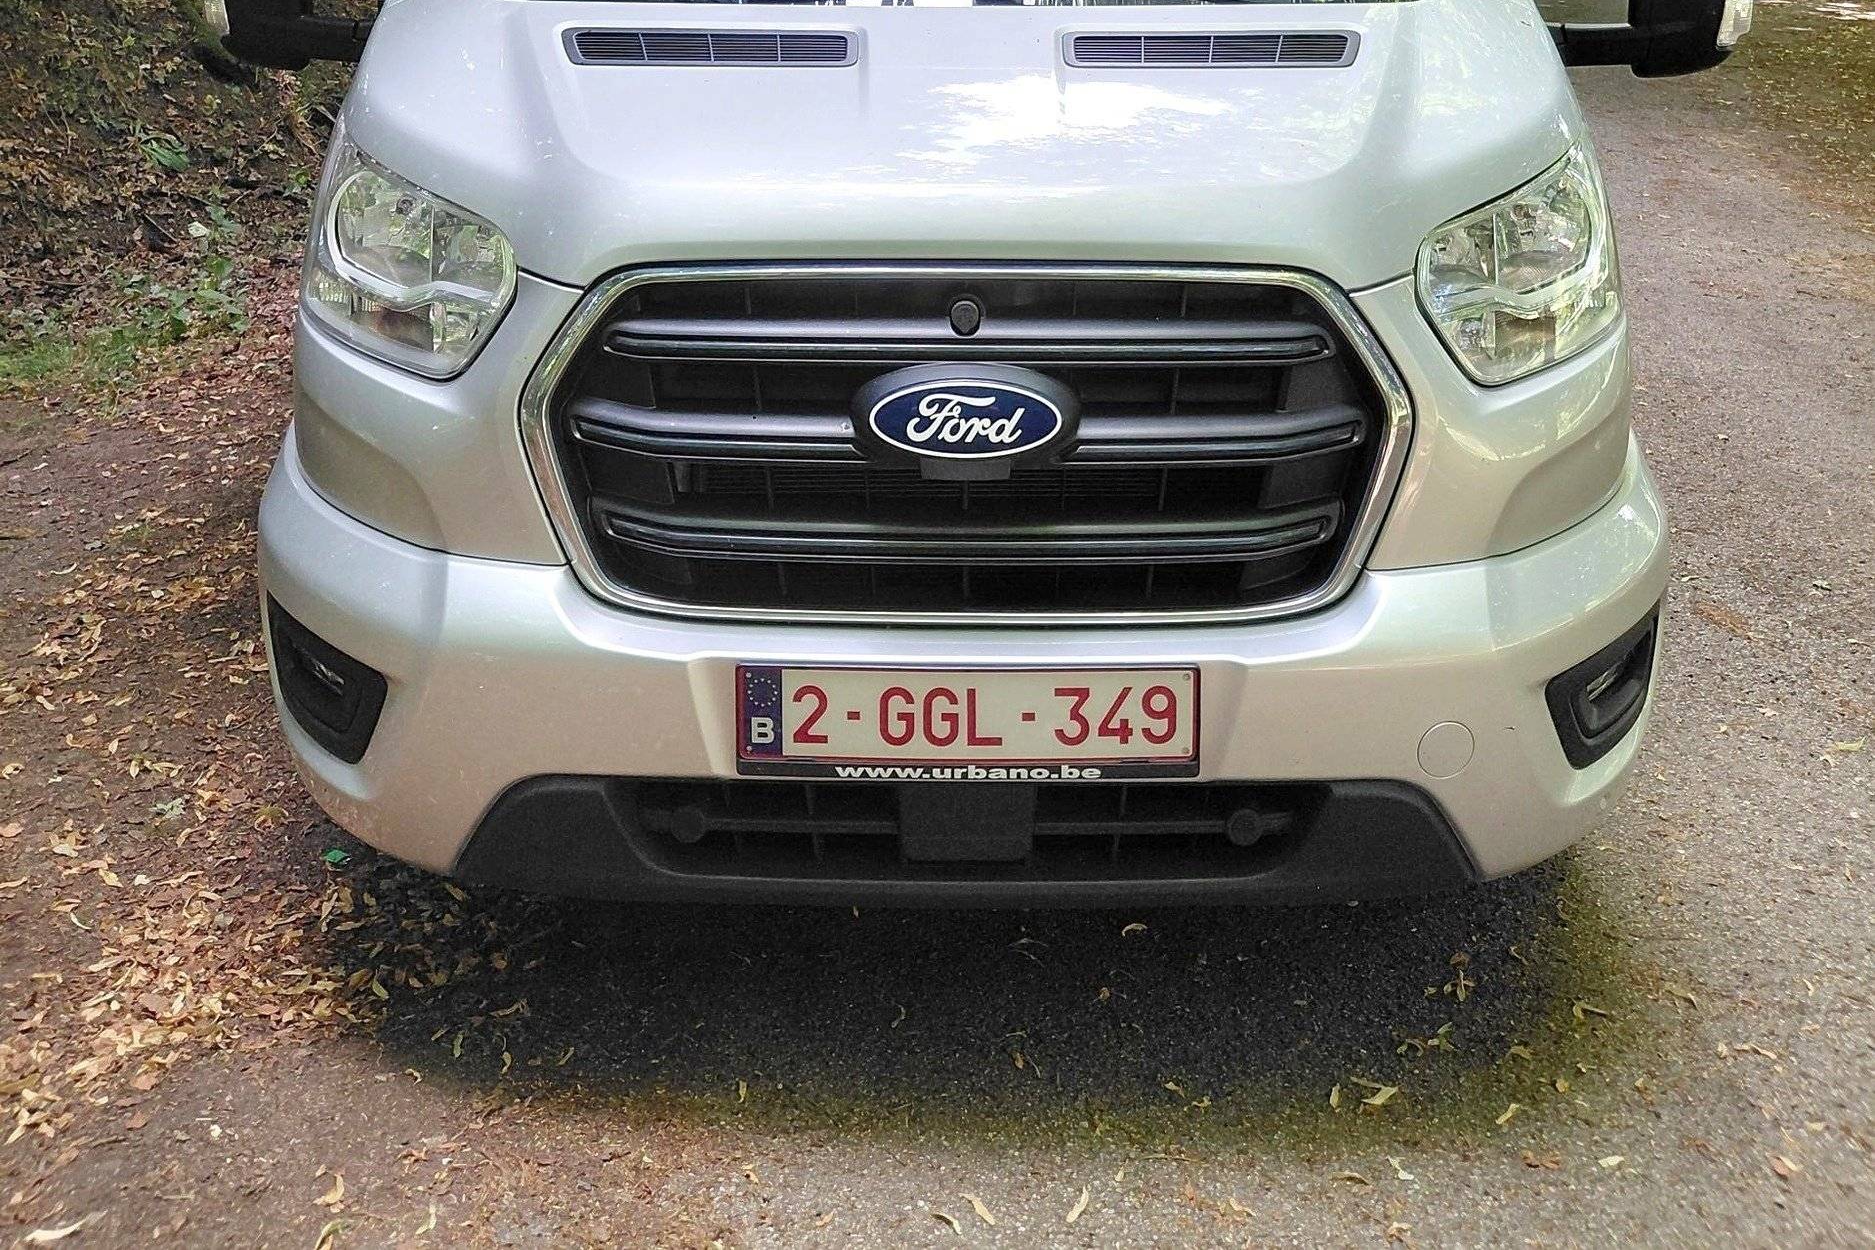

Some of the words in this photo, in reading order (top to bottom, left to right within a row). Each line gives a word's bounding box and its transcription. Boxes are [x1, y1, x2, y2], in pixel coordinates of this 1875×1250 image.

[906, 393, 1025, 444] Ford
[751, 717, 775, 744] B
[835, 765, 1101, 780] www.urbano.be
